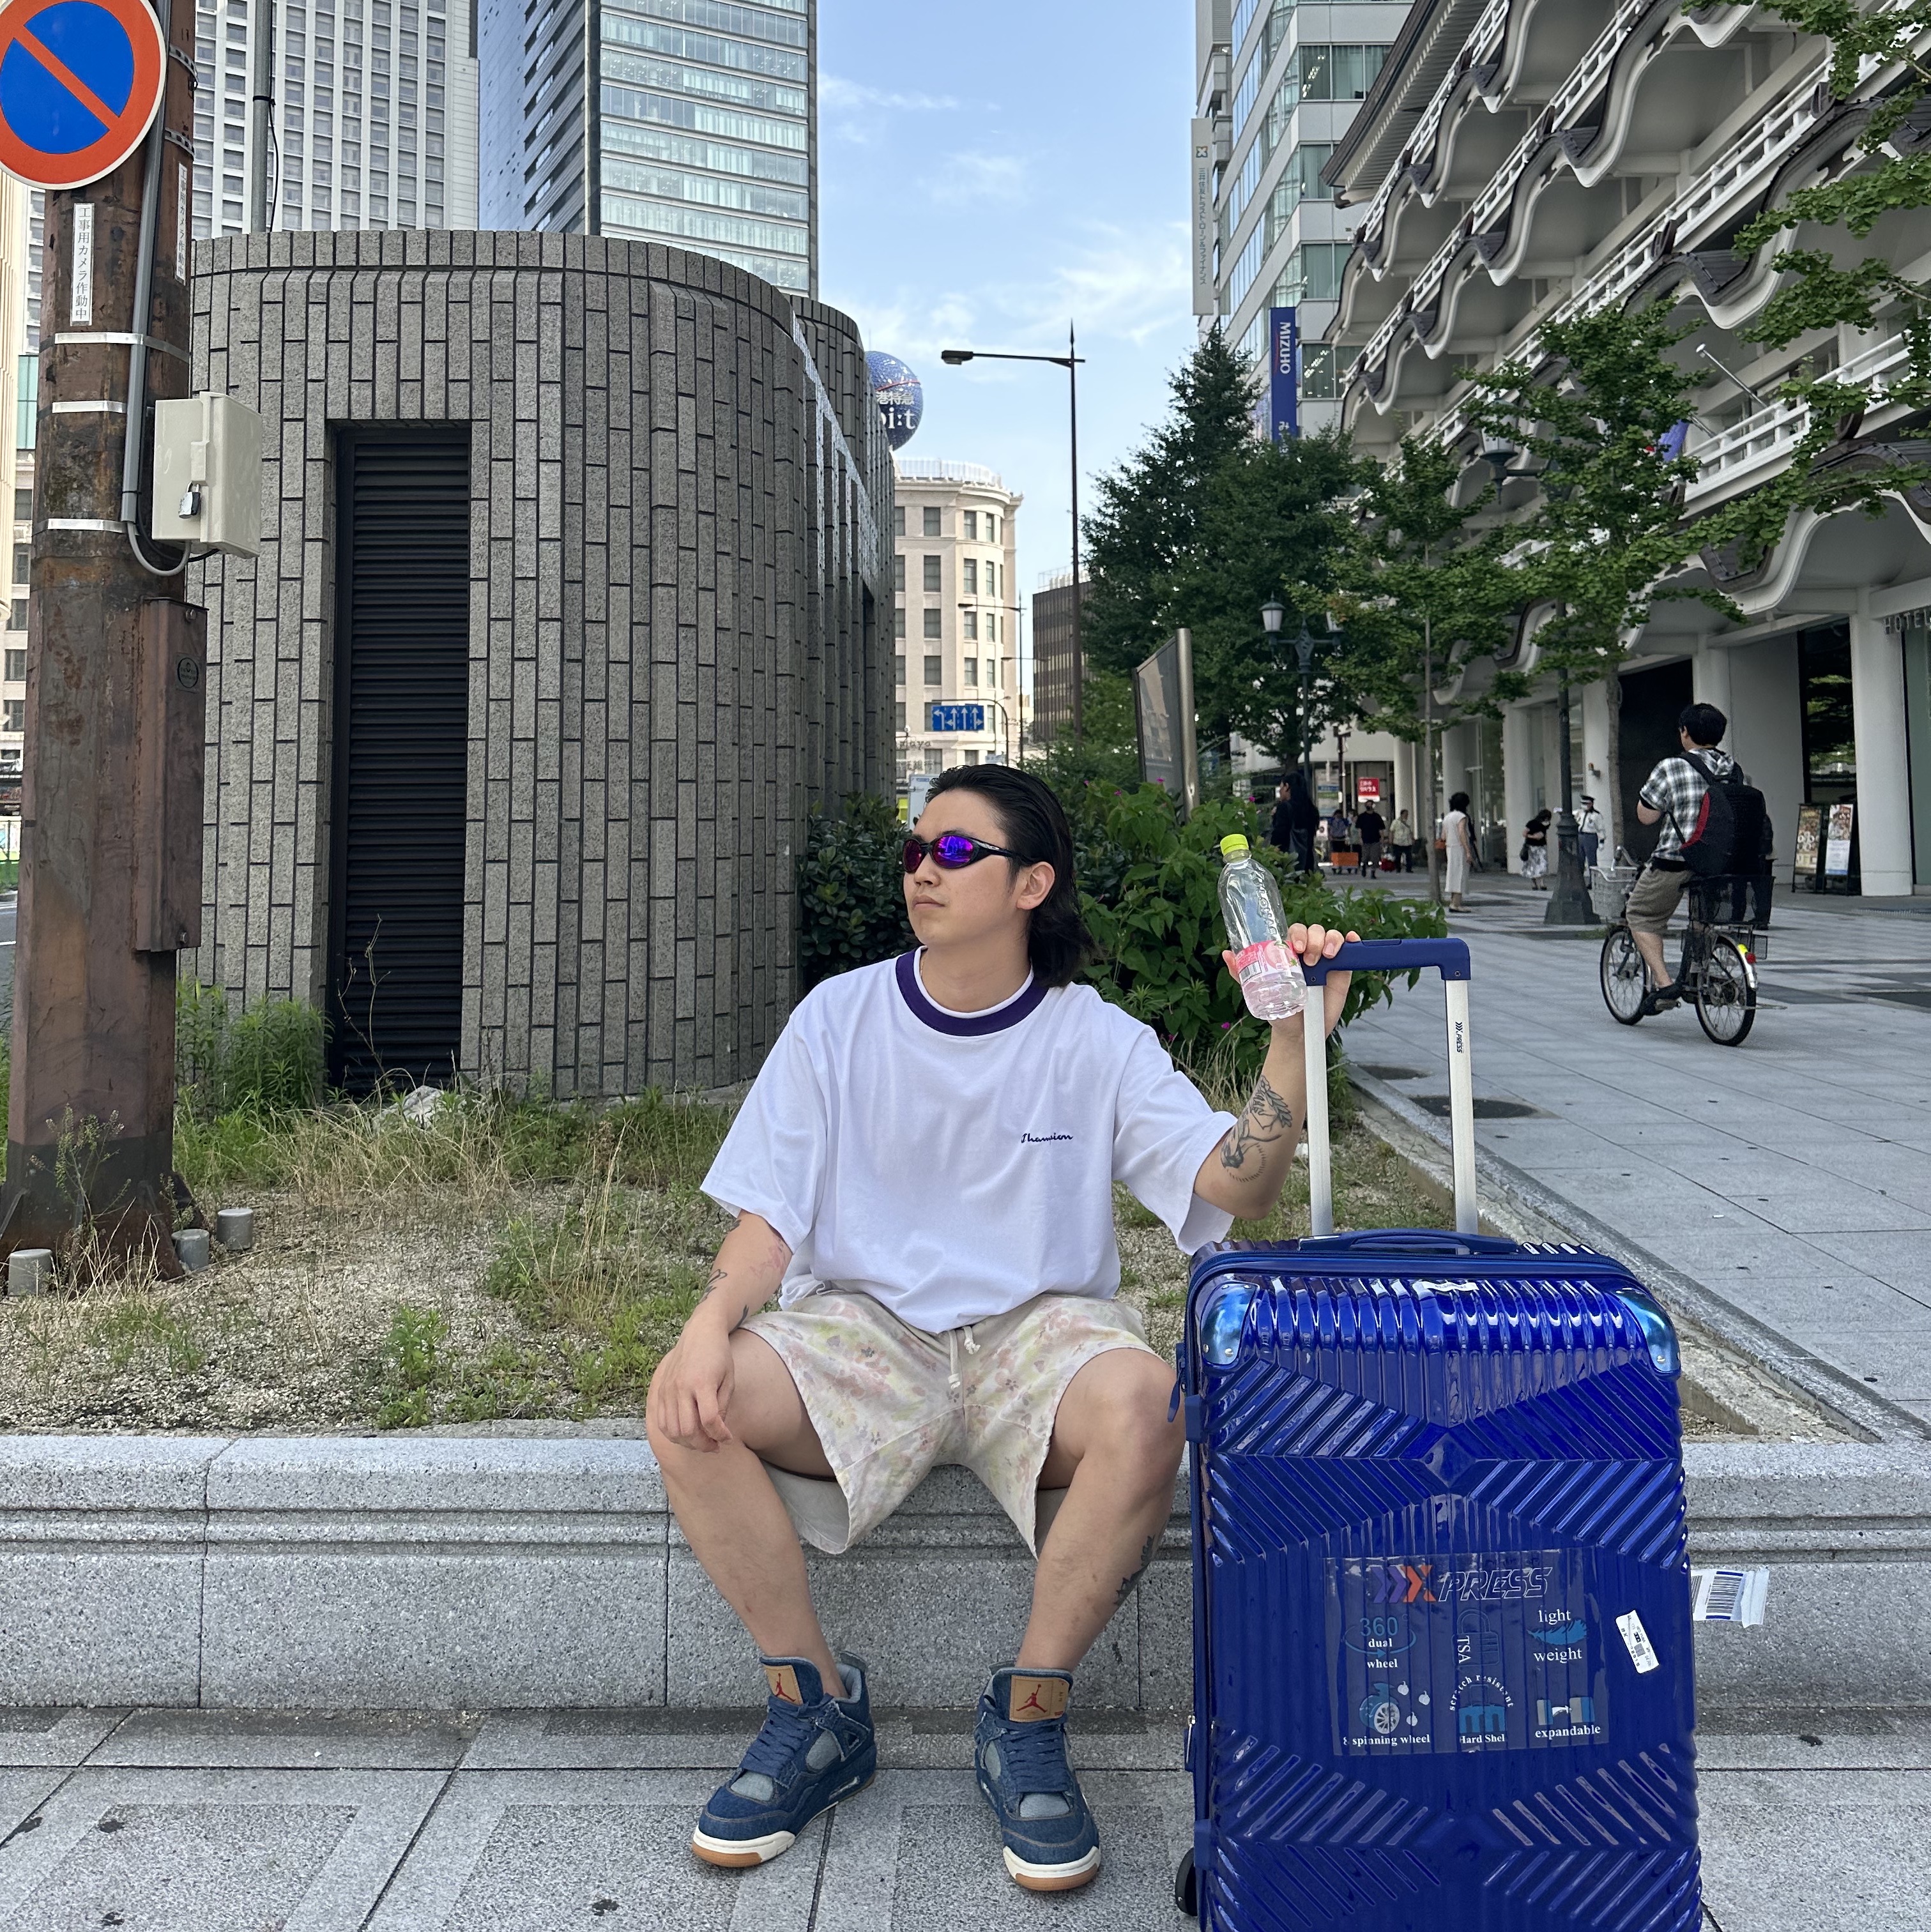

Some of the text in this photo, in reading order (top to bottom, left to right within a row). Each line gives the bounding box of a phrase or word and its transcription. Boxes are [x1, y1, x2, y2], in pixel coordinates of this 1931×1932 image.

[178, 167, 187, 277] 工事用カメラ作動中
[75, 207, 91, 320] 工事用カメラ作動中
[1279, 322, 1292, 374] MIZUHO
[1882, 608, 1931, 634] HOTEL
[1538, 1609, 1571, 1625] light
[1368, 1639, 1393, 1648] dual
[1457, 1636, 1471, 1664] TSA
[1533, 1647, 1582, 1663] weight
[1367, 1659, 1398, 1668] wheel
[1352, 1736, 1398, 1747] spinning
[1400, 1734, 1430, 1744] wheel
[1459, 1734, 1505, 1744] Hard Shel
[1535, 1725, 1601, 1740] expandable
